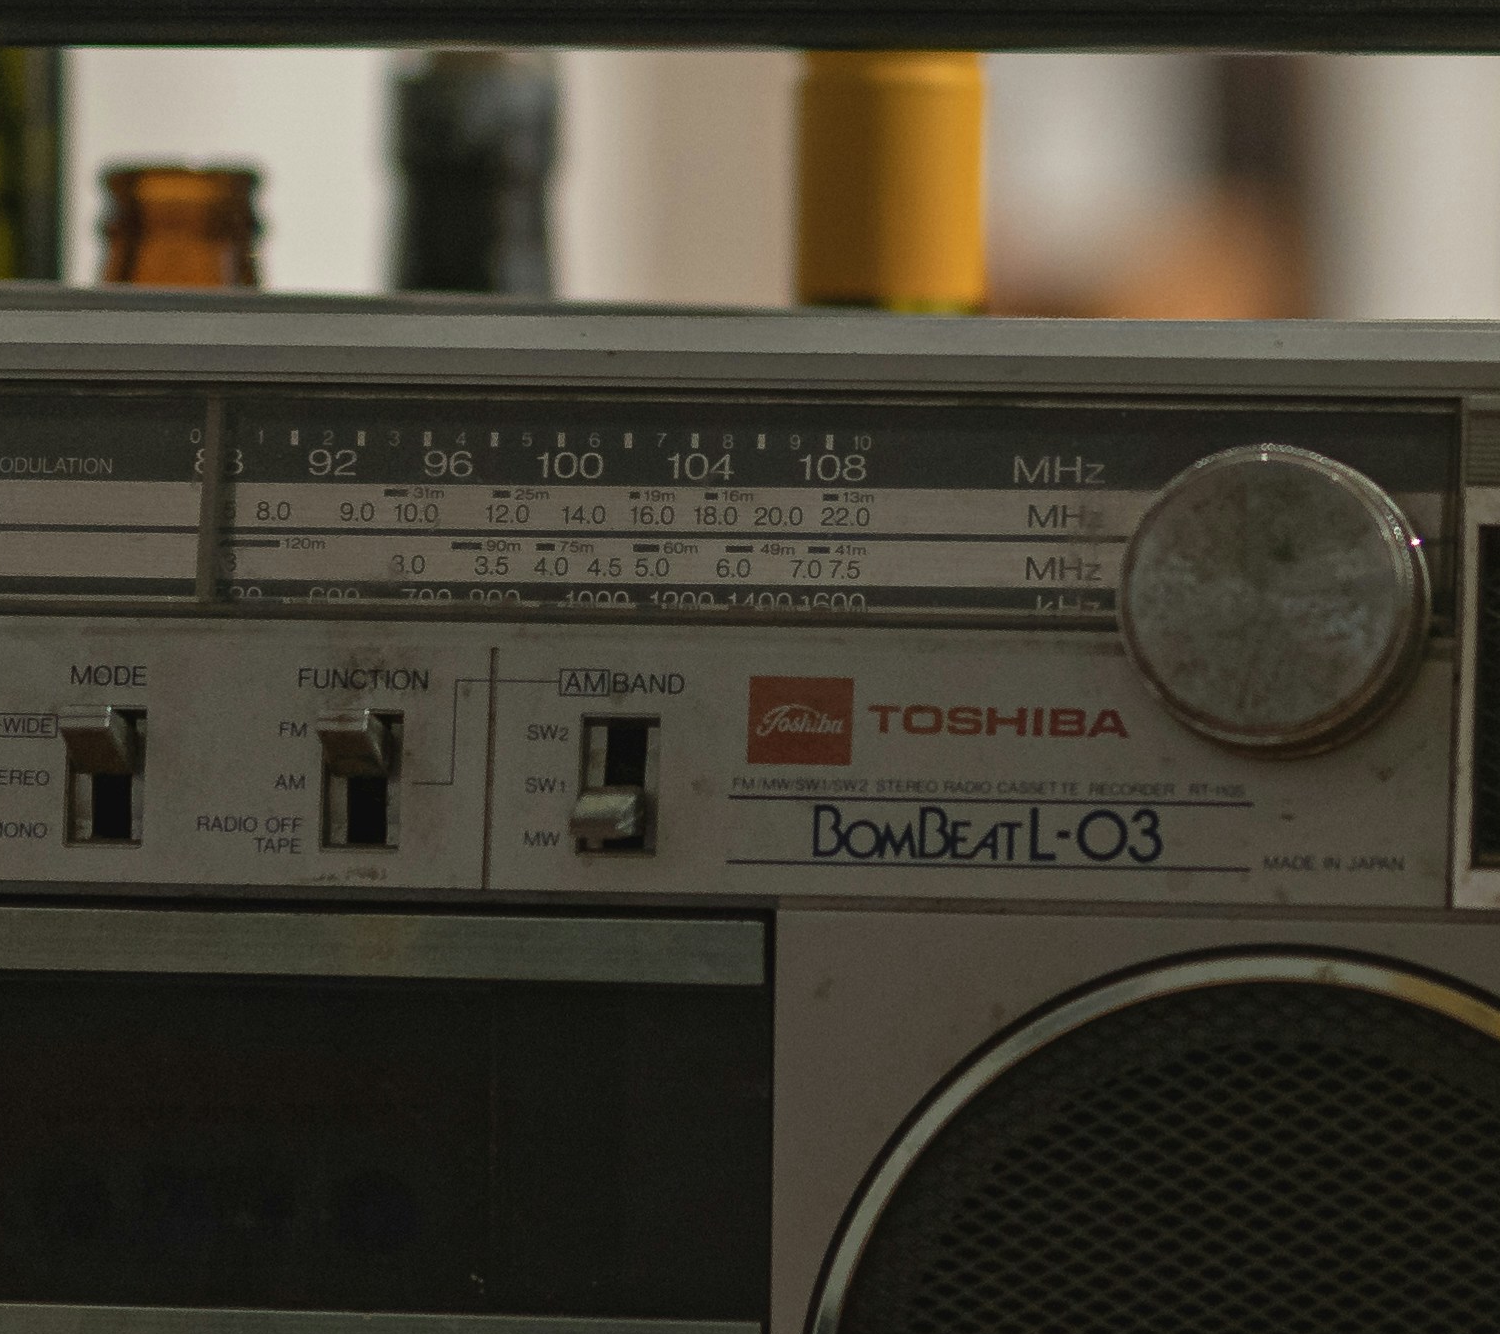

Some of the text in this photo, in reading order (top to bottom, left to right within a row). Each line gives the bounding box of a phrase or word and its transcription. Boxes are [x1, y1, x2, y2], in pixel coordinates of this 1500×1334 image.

[190, 428, 872, 451] 0 1 2 3 4 5 6 7 8 9 10
[308, 448, 358, 476] 92
[423, 449, 474, 478] 96
[537, 451, 604, 479] 100
[667, 453, 735, 480] 104
[799, 454, 867, 482] 108
[1013, 455, 1105, 484] MHz
[412, 487, 875, 504] 31m 25m 19m 16m 13m
[256, 501, 291, 521] 8.0
[339, 502, 375, 522] 9.0
[394, 503, 439, 524] 10.0
[485, 504, 530, 525] 12.0
[561, 505, 606, 525] 14.0
[630, 505, 675, 526] 16.0
[693, 506, 738, 527] 18.0
[753, 506, 803, 527] 20.0
[820, 507, 870, 528] 22.0
[284, 537, 867, 557] 120m 90m 75m 60m 49m 41m
[392, 554, 1102, 581] 3.0 3.5 4.0 4.5 5.0 6.0 7.0 7.5 MHz
[70, 665, 148, 687] MODE
[298, 668, 429, 691] FUNCTION
[564, 674, 686, 695] AM BAND
[756, 702, 845, 738] Toshiba
[868, 704, 1130, 739] TOSHIBA
[278, 722, 308, 738] FM
[527, 725, 569, 742] SW2
[274, 773, 305, 790] AM
[525, 778, 566, 794] SW1
[876, 778, 939, 795] STEREO
[943, 779, 992, 795] RADIO
[1088, 781, 1176, 797] RECORDER
[196, 816, 304, 833] RADIO OFF
[253, 837, 302, 854] TAPE
[523, 830, 561, 847] MW
[1264, 855, 1405, 871] MADE IN JAPAN
